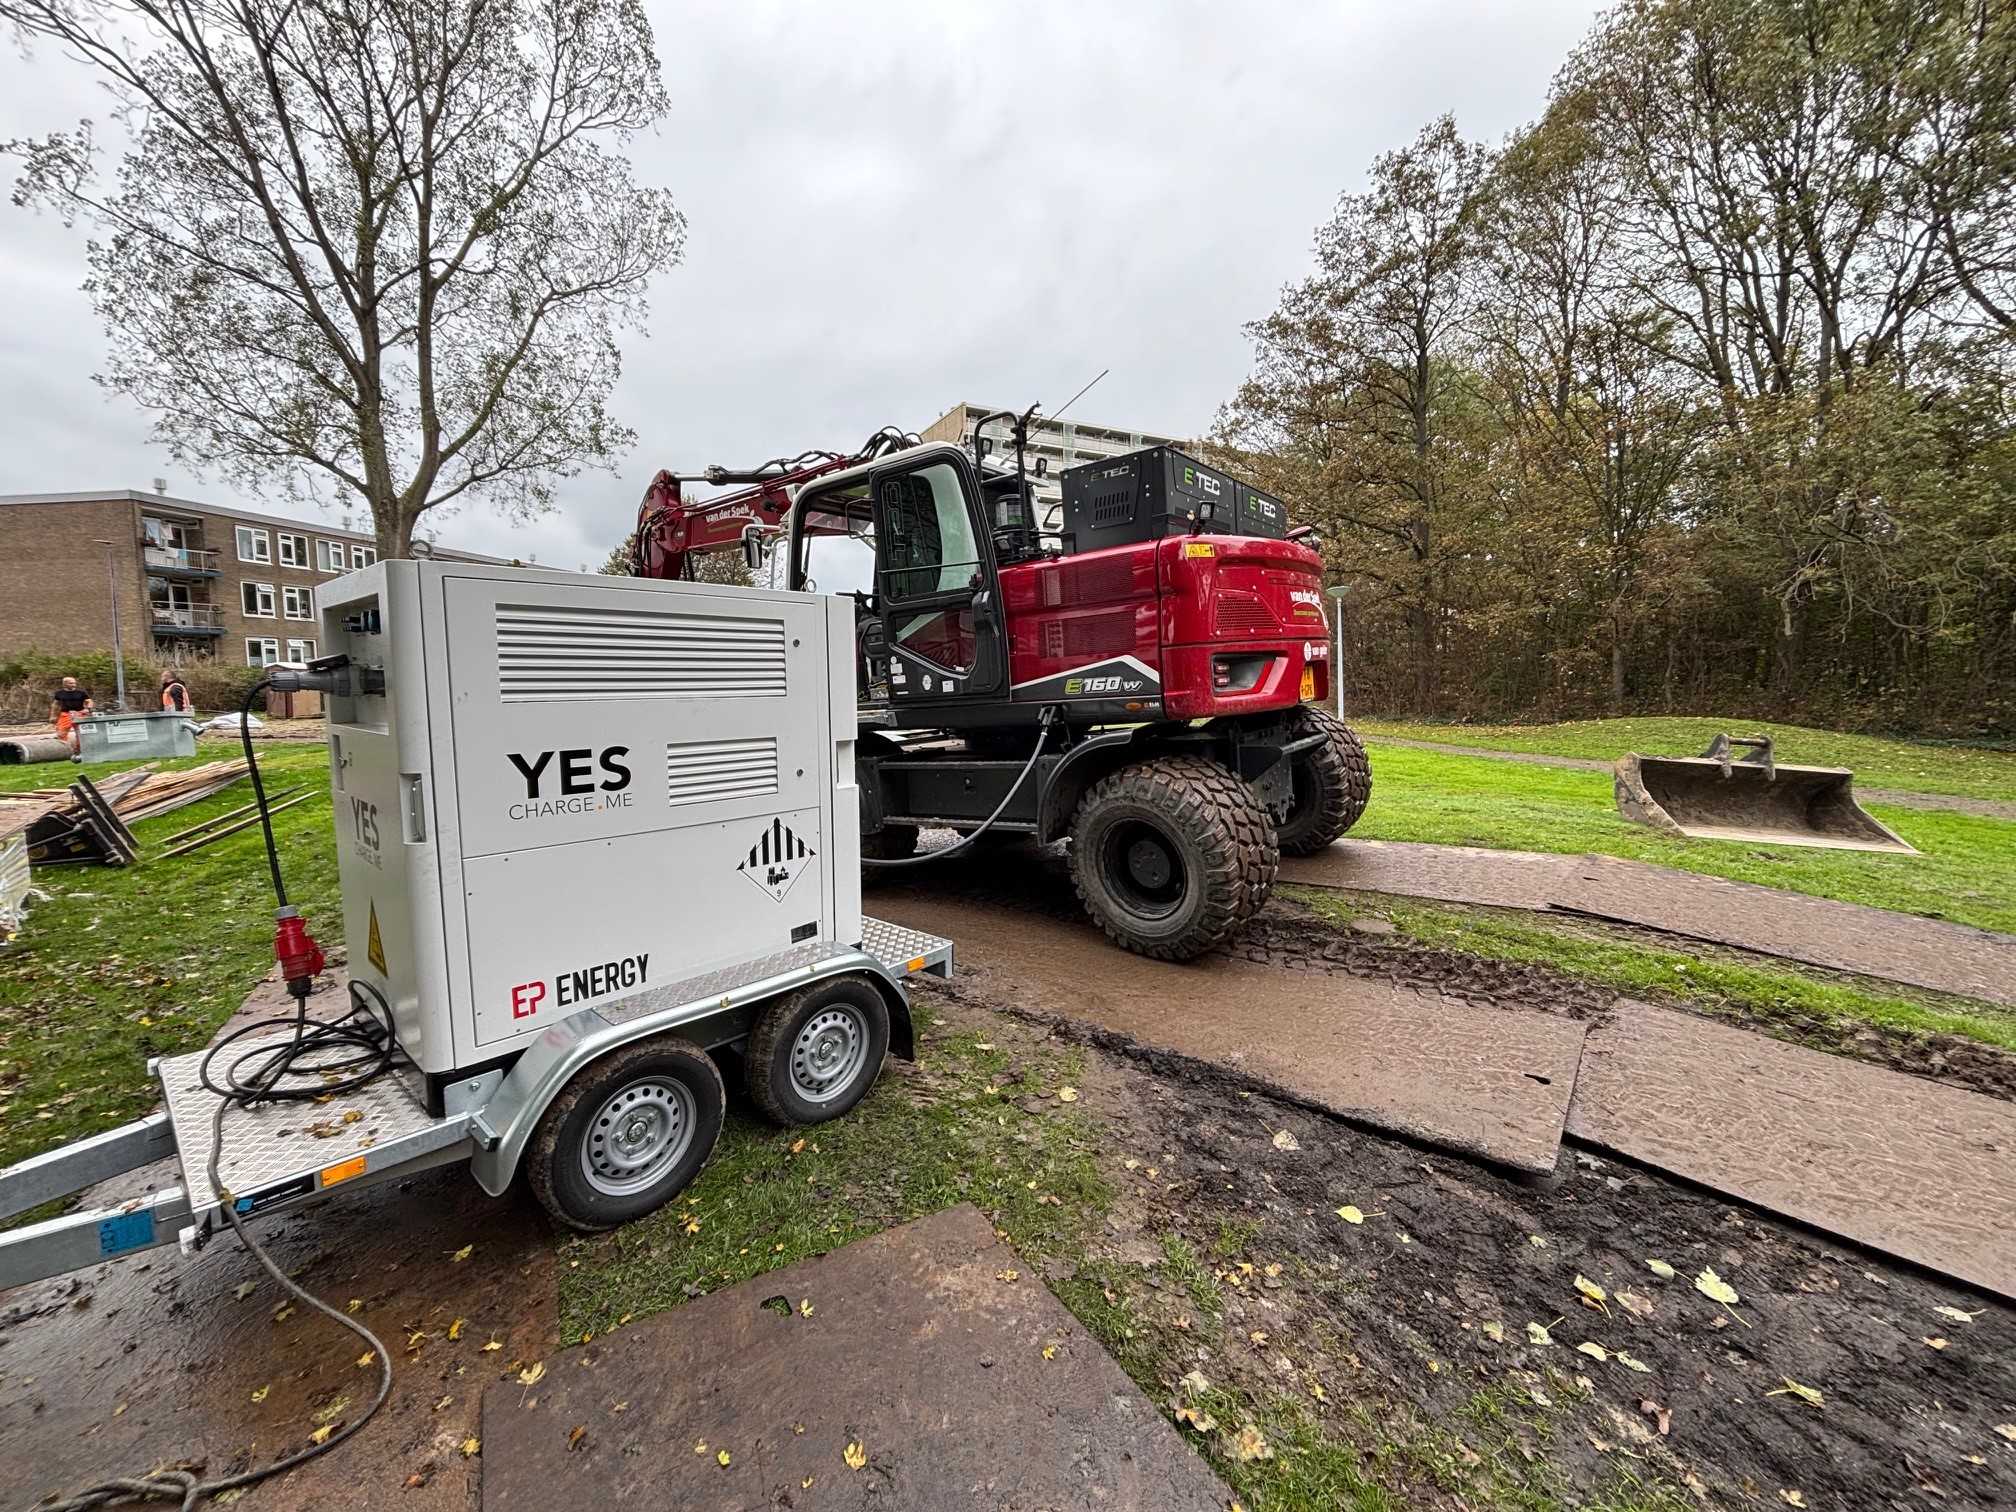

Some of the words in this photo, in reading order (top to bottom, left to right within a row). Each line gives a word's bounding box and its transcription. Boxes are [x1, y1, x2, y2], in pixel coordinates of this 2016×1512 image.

[706, 513, 720, 522] van
[720, 509, 731, 519] der
[506, 746, 631, 799] YES
[350, 796, 380, 851] YES
[776, 889, 782, 897] 9
[511, 981, 546, 1019] EP
[556, 953, 649, 1007] ENERGY
